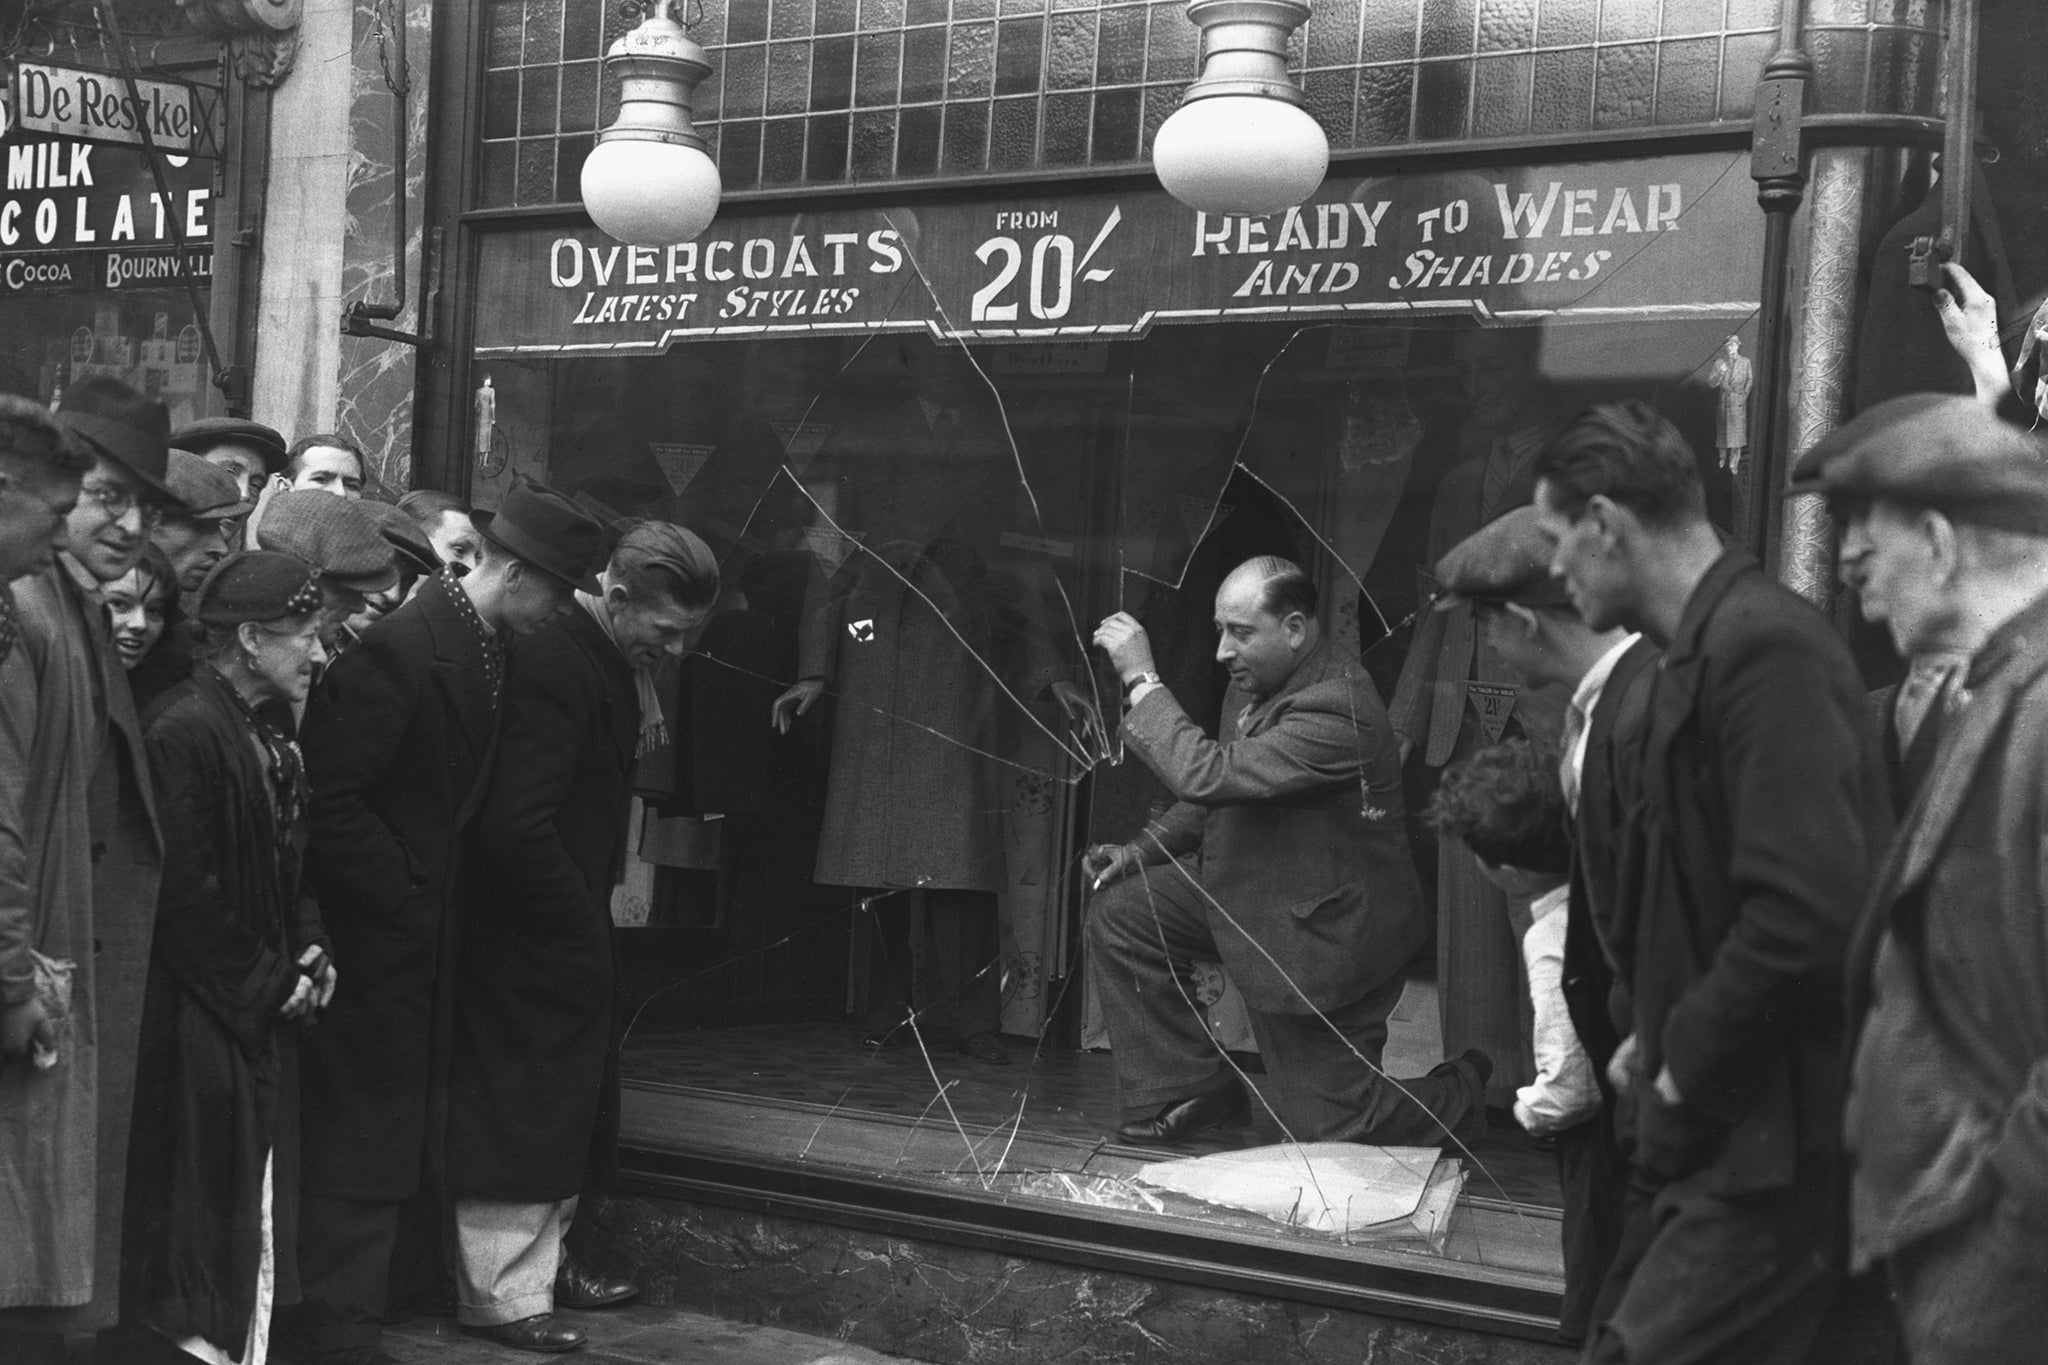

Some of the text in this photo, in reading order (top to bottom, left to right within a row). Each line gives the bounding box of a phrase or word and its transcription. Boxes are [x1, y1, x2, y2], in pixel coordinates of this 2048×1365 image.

[22, 68, 71, 122] De
[7, 142, 94, 190] MILK
[996, 210, 1059, 230] FROM
[1192, 181, 1680, 257] READY TO WEAR
[550, 229, 903, 288] OVERCOATS
[1232, 249, 1612, 298] AND SHADES
[572, 285, 860, 325] LATEST STYLES
